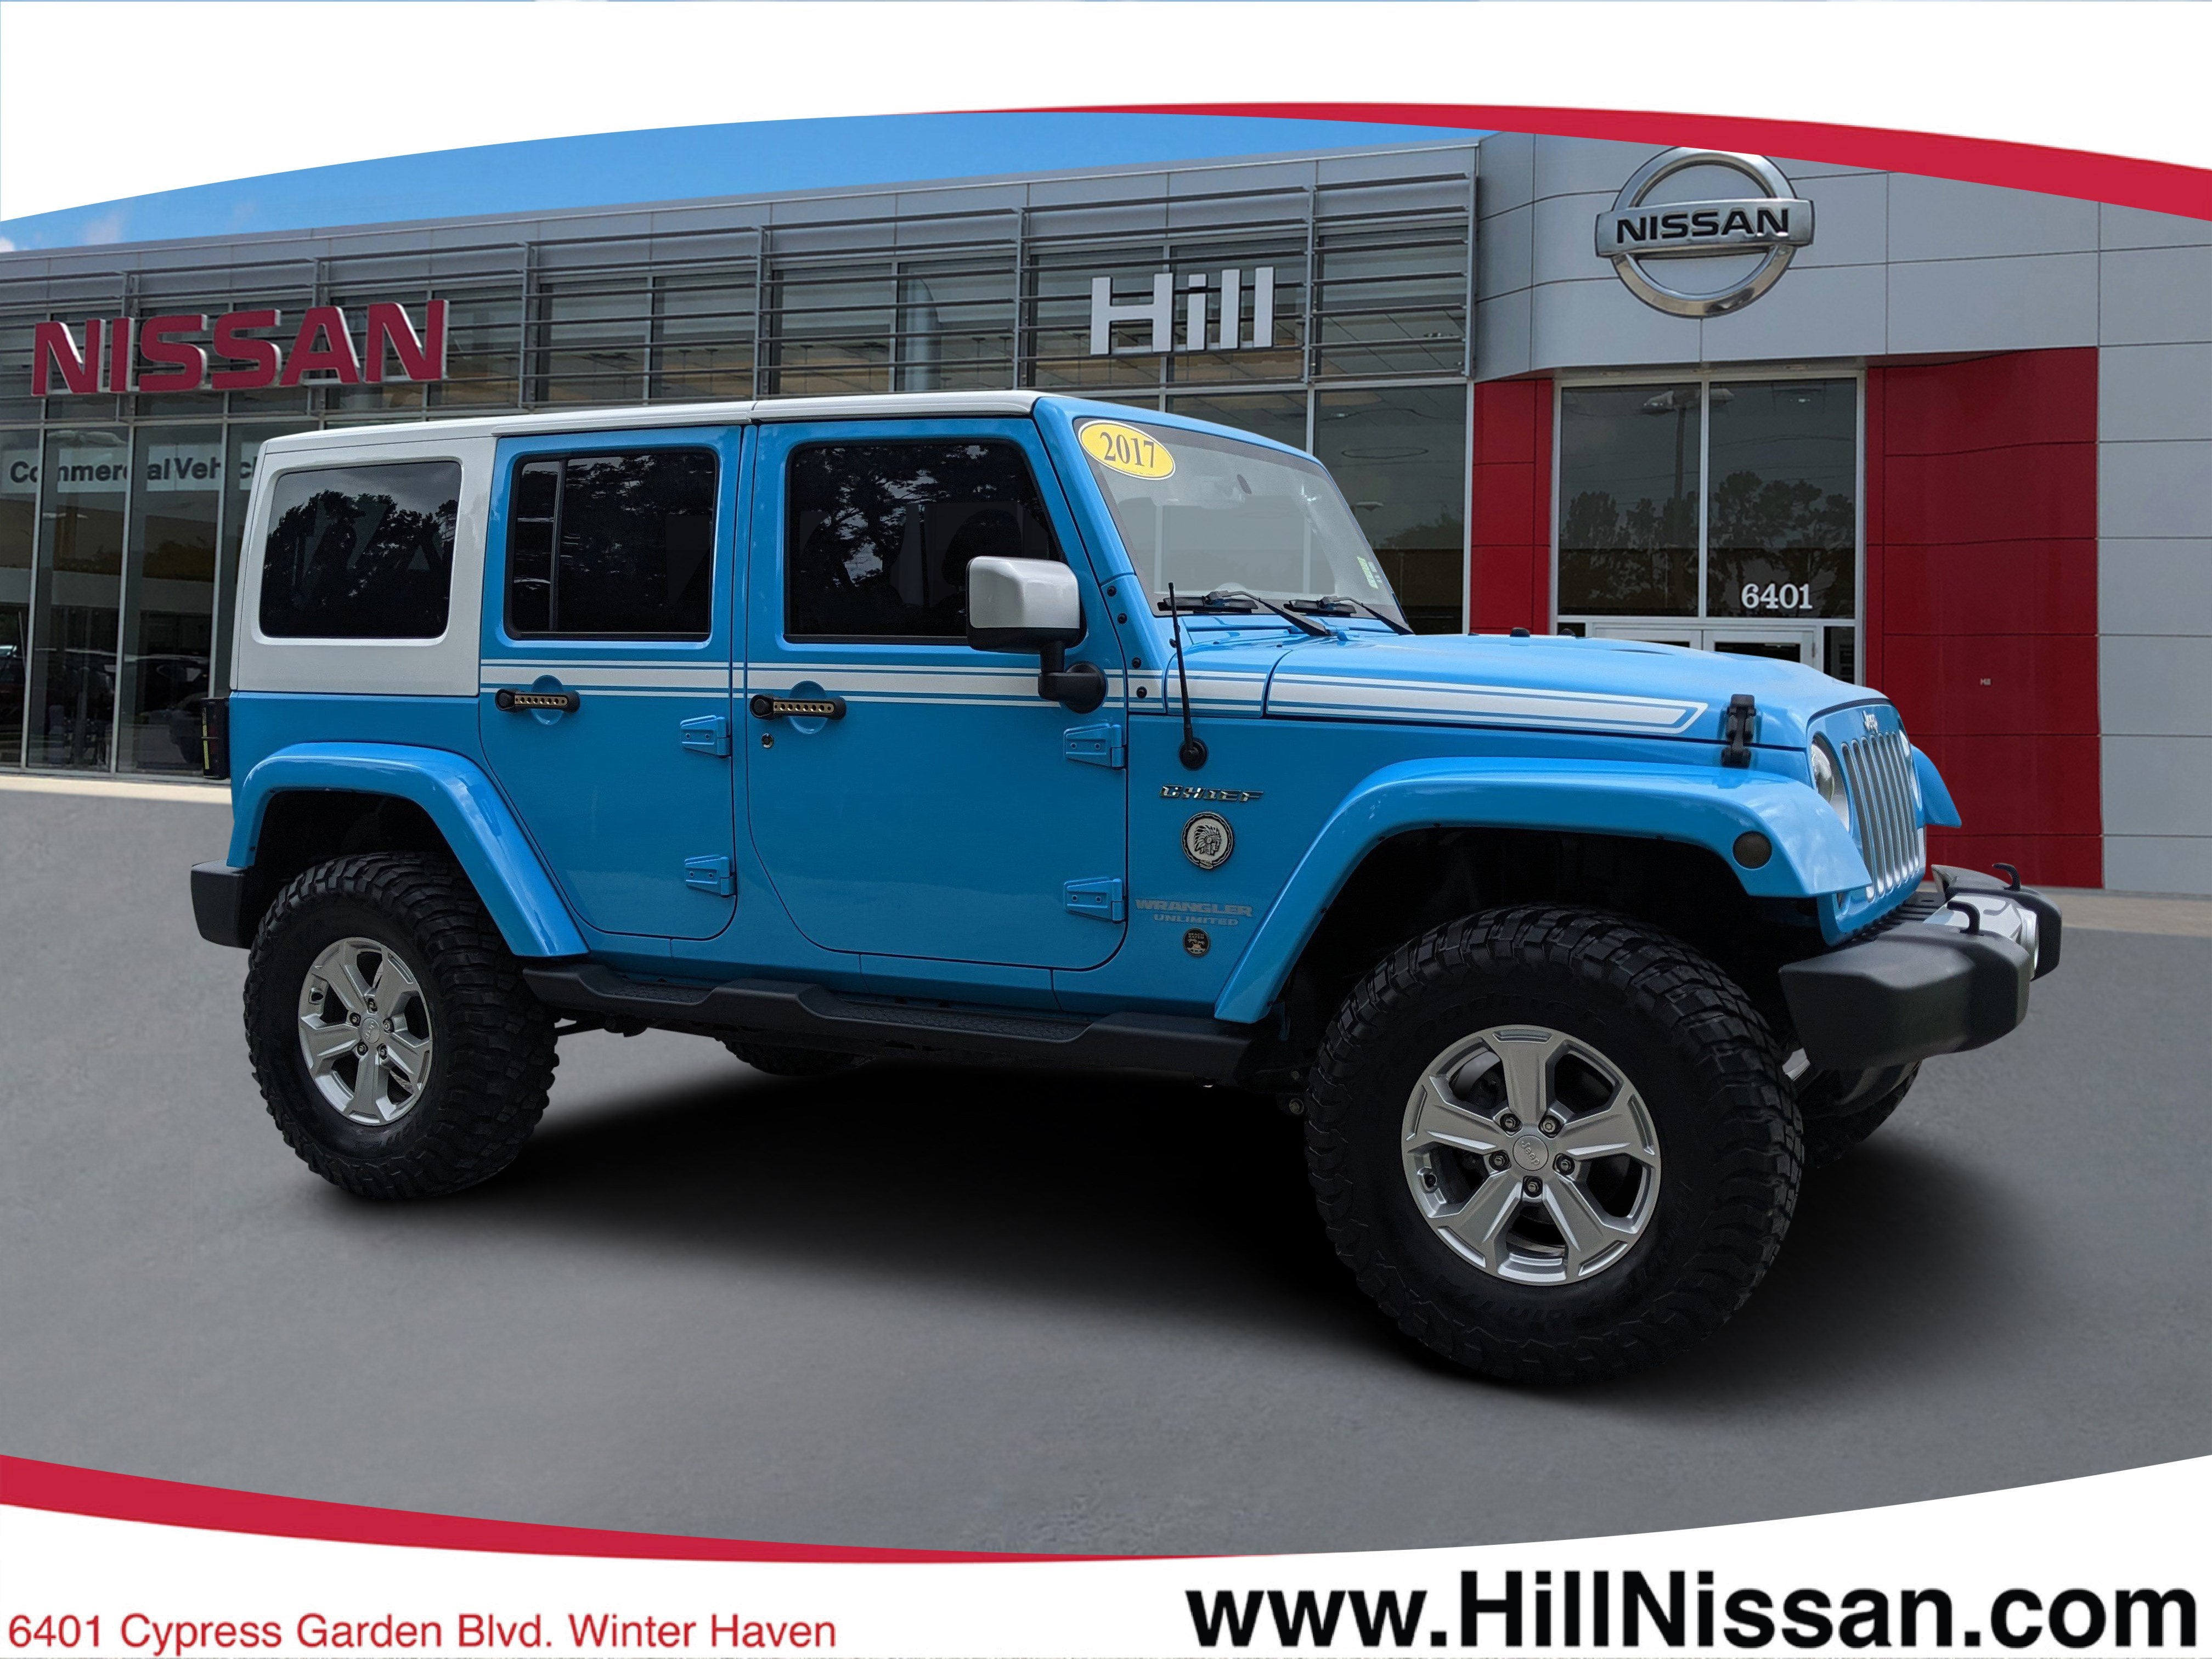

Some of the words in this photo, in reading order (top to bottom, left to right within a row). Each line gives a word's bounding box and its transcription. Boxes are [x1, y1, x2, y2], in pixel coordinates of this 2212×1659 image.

[1617, 208, 1790, 244] NISSAN
[1090, 266, 1274, 356] Hill
[32, 300, 448, 396] NISSAN
[1100, 432, 1155, 469] 2017
[1741, 583, 1813, 610] 6401
[1159, 785, 1264, 802] CHIEF
[1135, 899, 1254, 917] WRANGLER
[1153, 914, 1239, 927] UNLIMITED
[1521, 1141, 1540, 1165] Jeep
